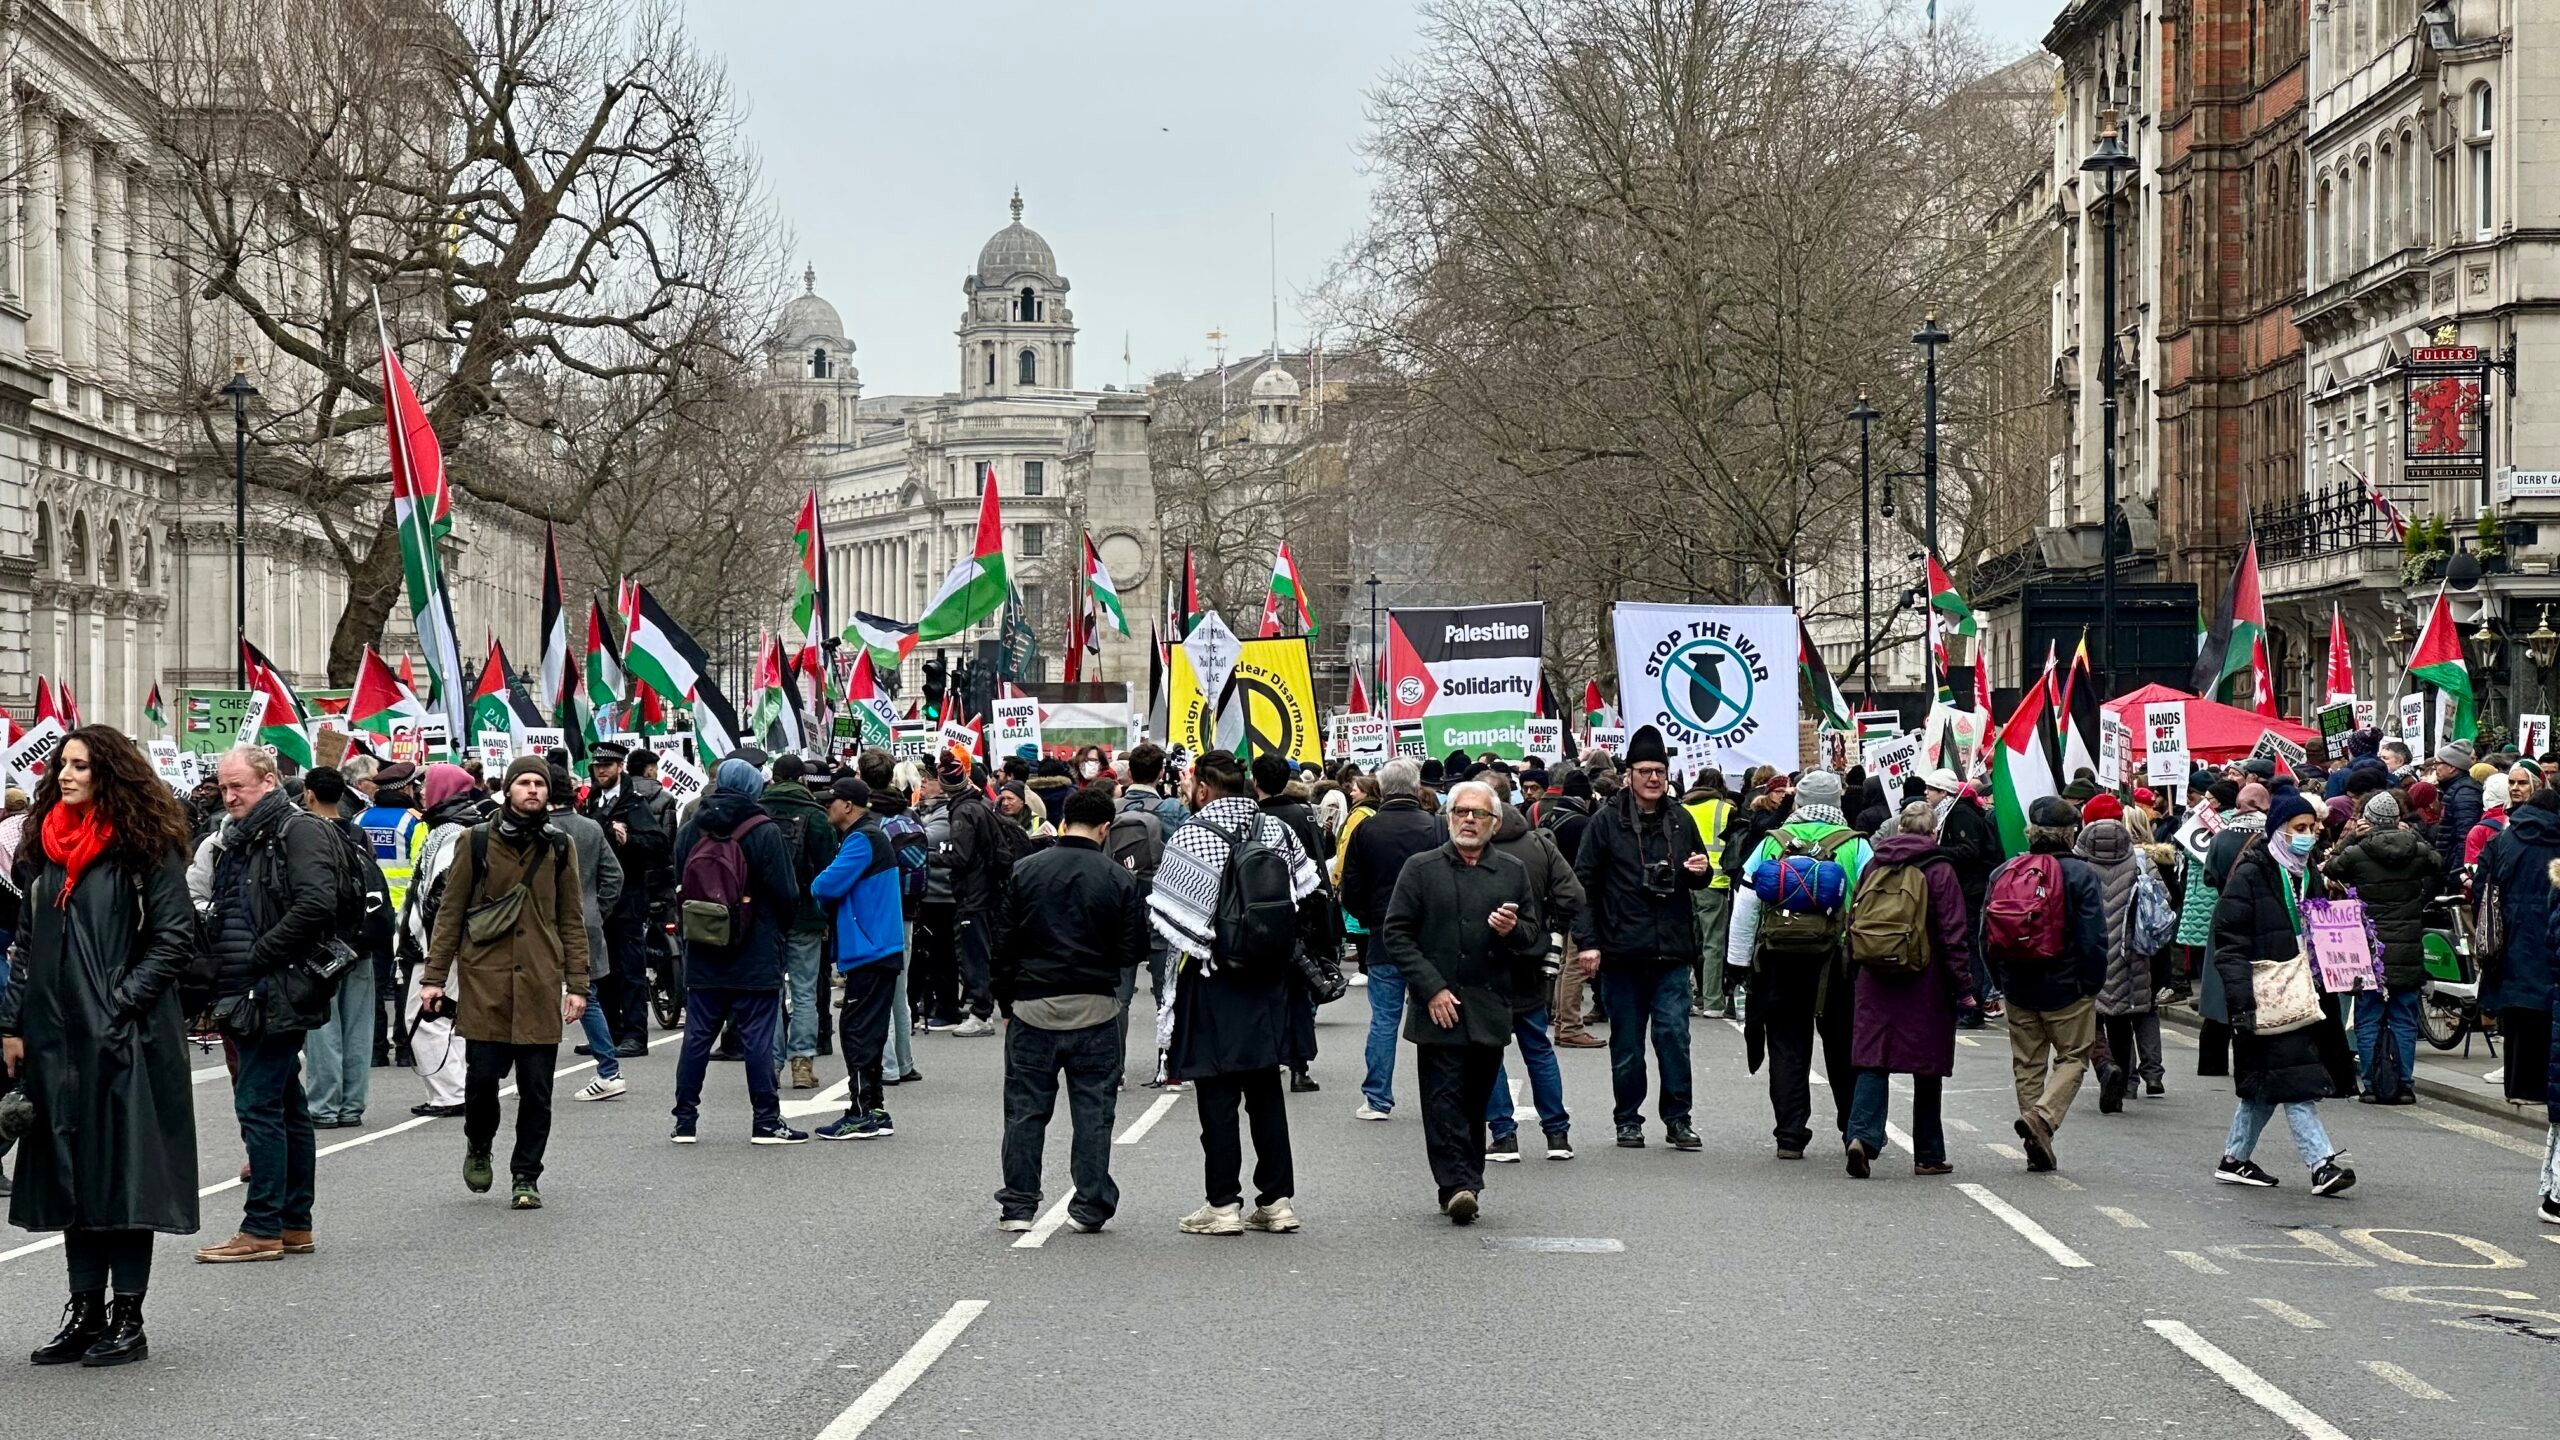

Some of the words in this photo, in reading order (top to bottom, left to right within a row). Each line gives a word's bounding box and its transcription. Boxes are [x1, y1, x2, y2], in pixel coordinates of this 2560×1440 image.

[2416, 349, 2473, 360] FULLER'S
[2517, 475, 2548, 485] DERBY
[1444, 622, 1529, 643] Palestine
[1645, 630, 1682, 678] STOP
[1688, 621, 1731, 642] THE
[1734, 633, 1769, 683] WAR
[1234, 661, 1269, 677] clear
[1402, 686, 1418, 696] PSC
[1442, 675, 1533, 697] Solidarity
[998, 705, 1034, 718] HANDS
[2402, 702, 2421, 715] HANDS
[2149, 712, 2180, 726] HANDS
[2523, 721, 2547, 730] HNDS
[1002, 727, 1033, 739] GAZA!
[1352, 724, 1383, 735] STOP
[1528, 726, 1558, 734] HANDS
[2102, 719, 2117, 734] HANDS
[2404, 726, 2421, 739] GAZA!
[527, 735, 559, 745] HANDS
[944, 728, 973, 745] HANDS
[1352, 734, 1384, 742] ARMING
[1443, 725, 1524, 747] Campaig
[1595, 734, 1625, 743] HANDS
[482, 738, 508, 748] HANDS
[653, 740, 680, 749] HANDS
[892, 742, 925, 756] FREE
[1395, 742, 1425, 756] FREE
[1529, 744, 1556, 753] GAZA!
[2152, 740, 2180, 753] GAZA!
[11, 731, 59, 773] HANDS
[1878, 744, 1915, 768] HANDS
[2102, 745, 2116, 759] GAZA!
[661, 759, 700, 793] HANDS
[2317, 905, 2360, 924] OURAGE
[2329, 932, 2343, 943] IS
